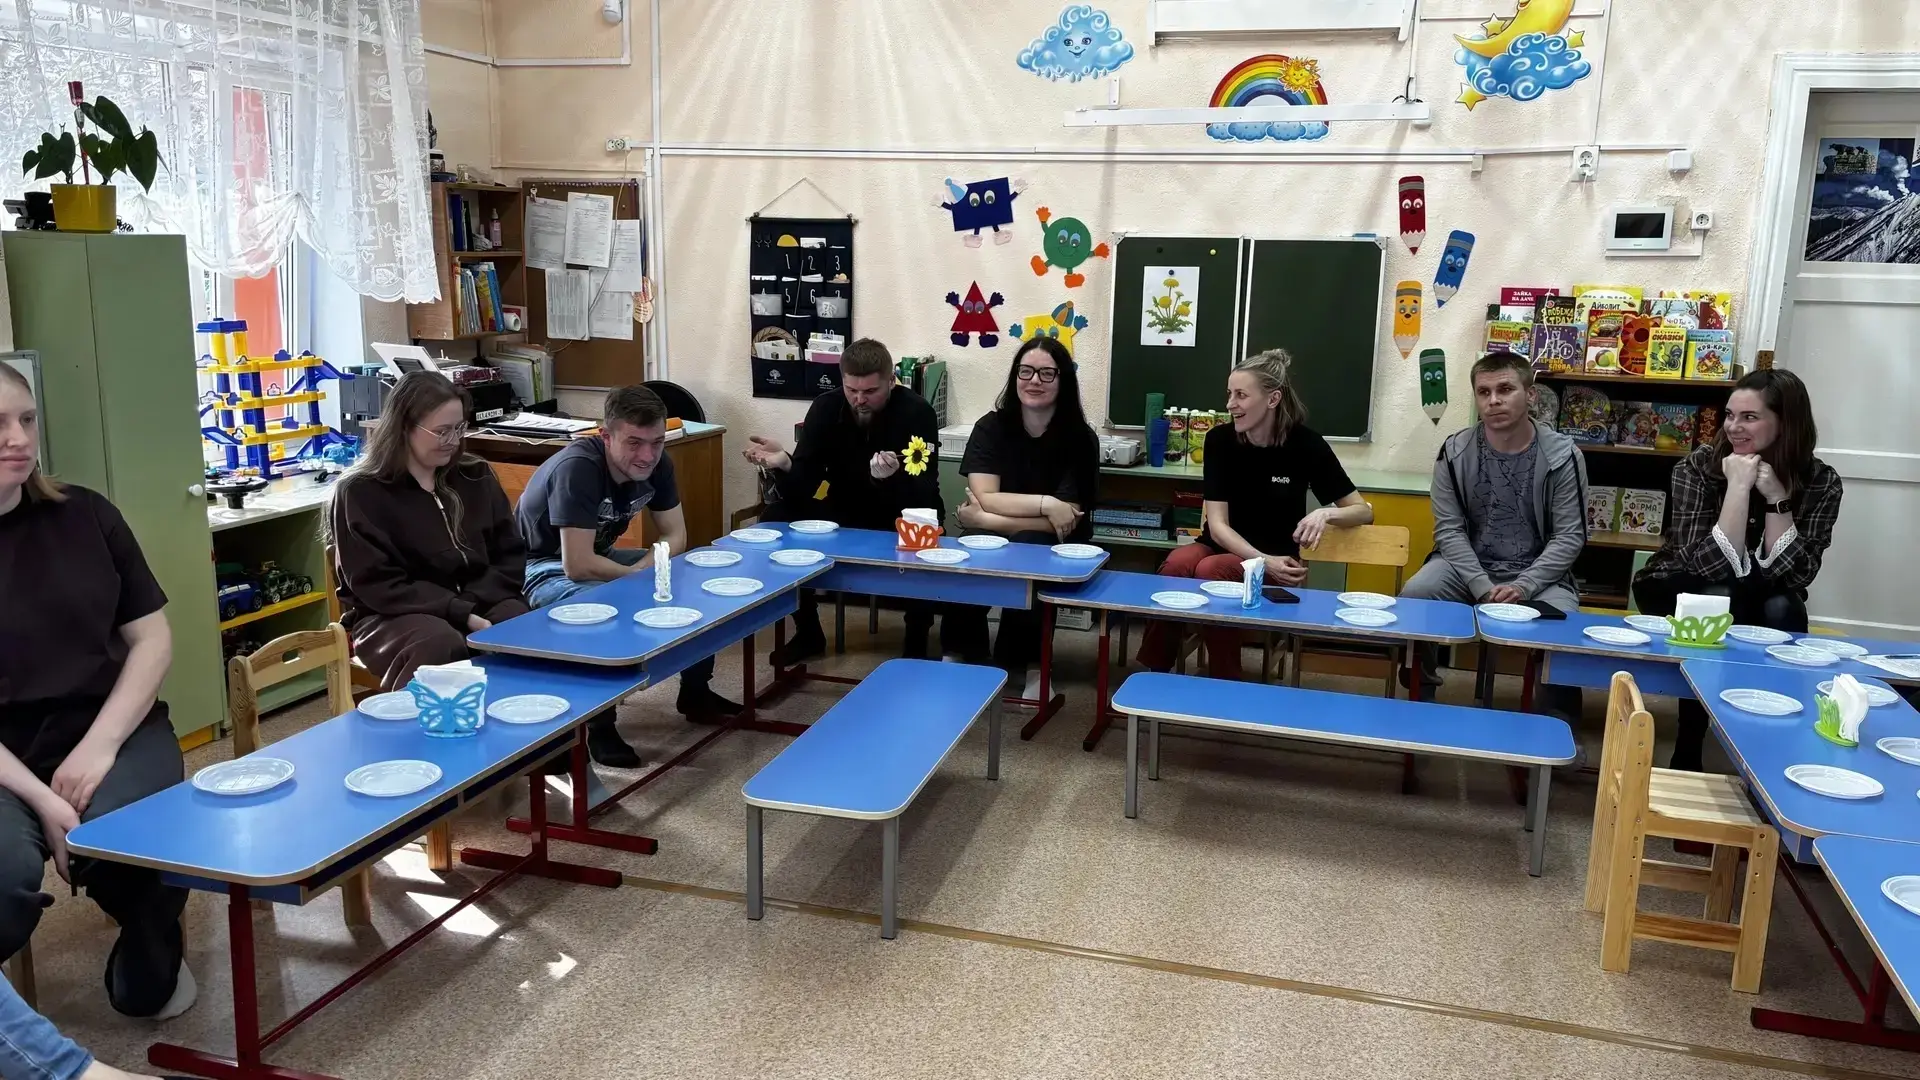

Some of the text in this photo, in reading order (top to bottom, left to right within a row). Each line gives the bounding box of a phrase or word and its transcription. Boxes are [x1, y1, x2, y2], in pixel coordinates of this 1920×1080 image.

[785, 253, 791, 270] 1
[808, 255, 816, 271] 2
[834, 255, 841, 271] 3
[785, 288, 791, 303] 5
[810, 288, 816, 304] 6
[1697, 344, 1730, 354] КРЯ-КРЯ!
[1549, 363, 1571, 371] СЛОВА
